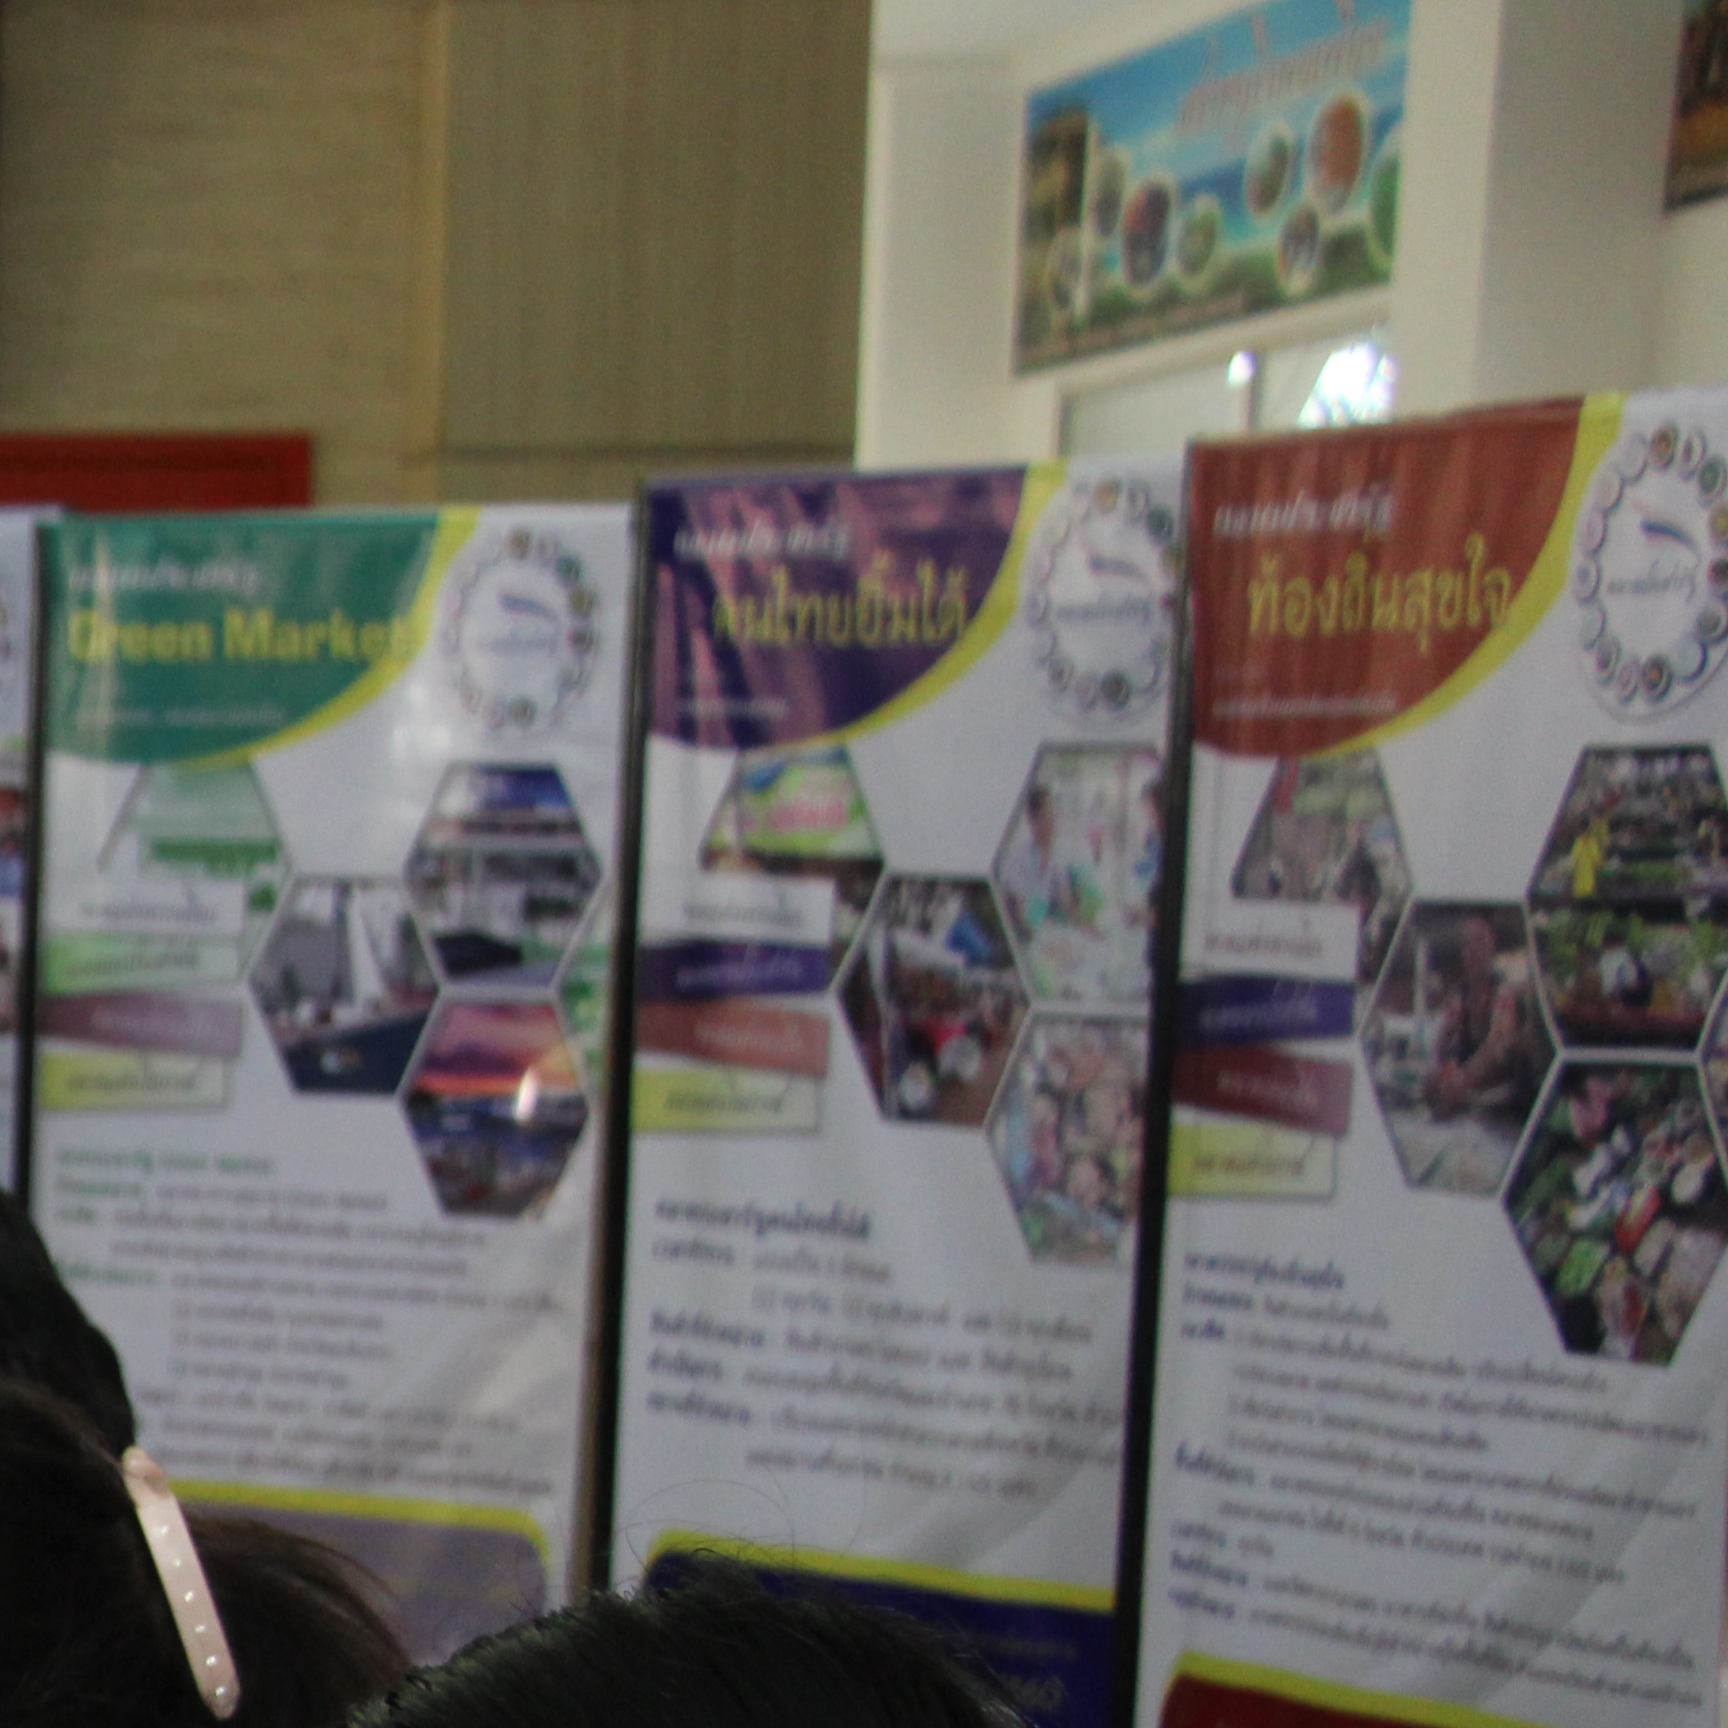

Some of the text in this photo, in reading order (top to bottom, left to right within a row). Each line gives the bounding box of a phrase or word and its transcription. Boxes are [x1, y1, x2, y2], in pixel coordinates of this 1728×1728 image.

[1247, 530, 1513, 656] ท้องถิ่นสุขใจ
